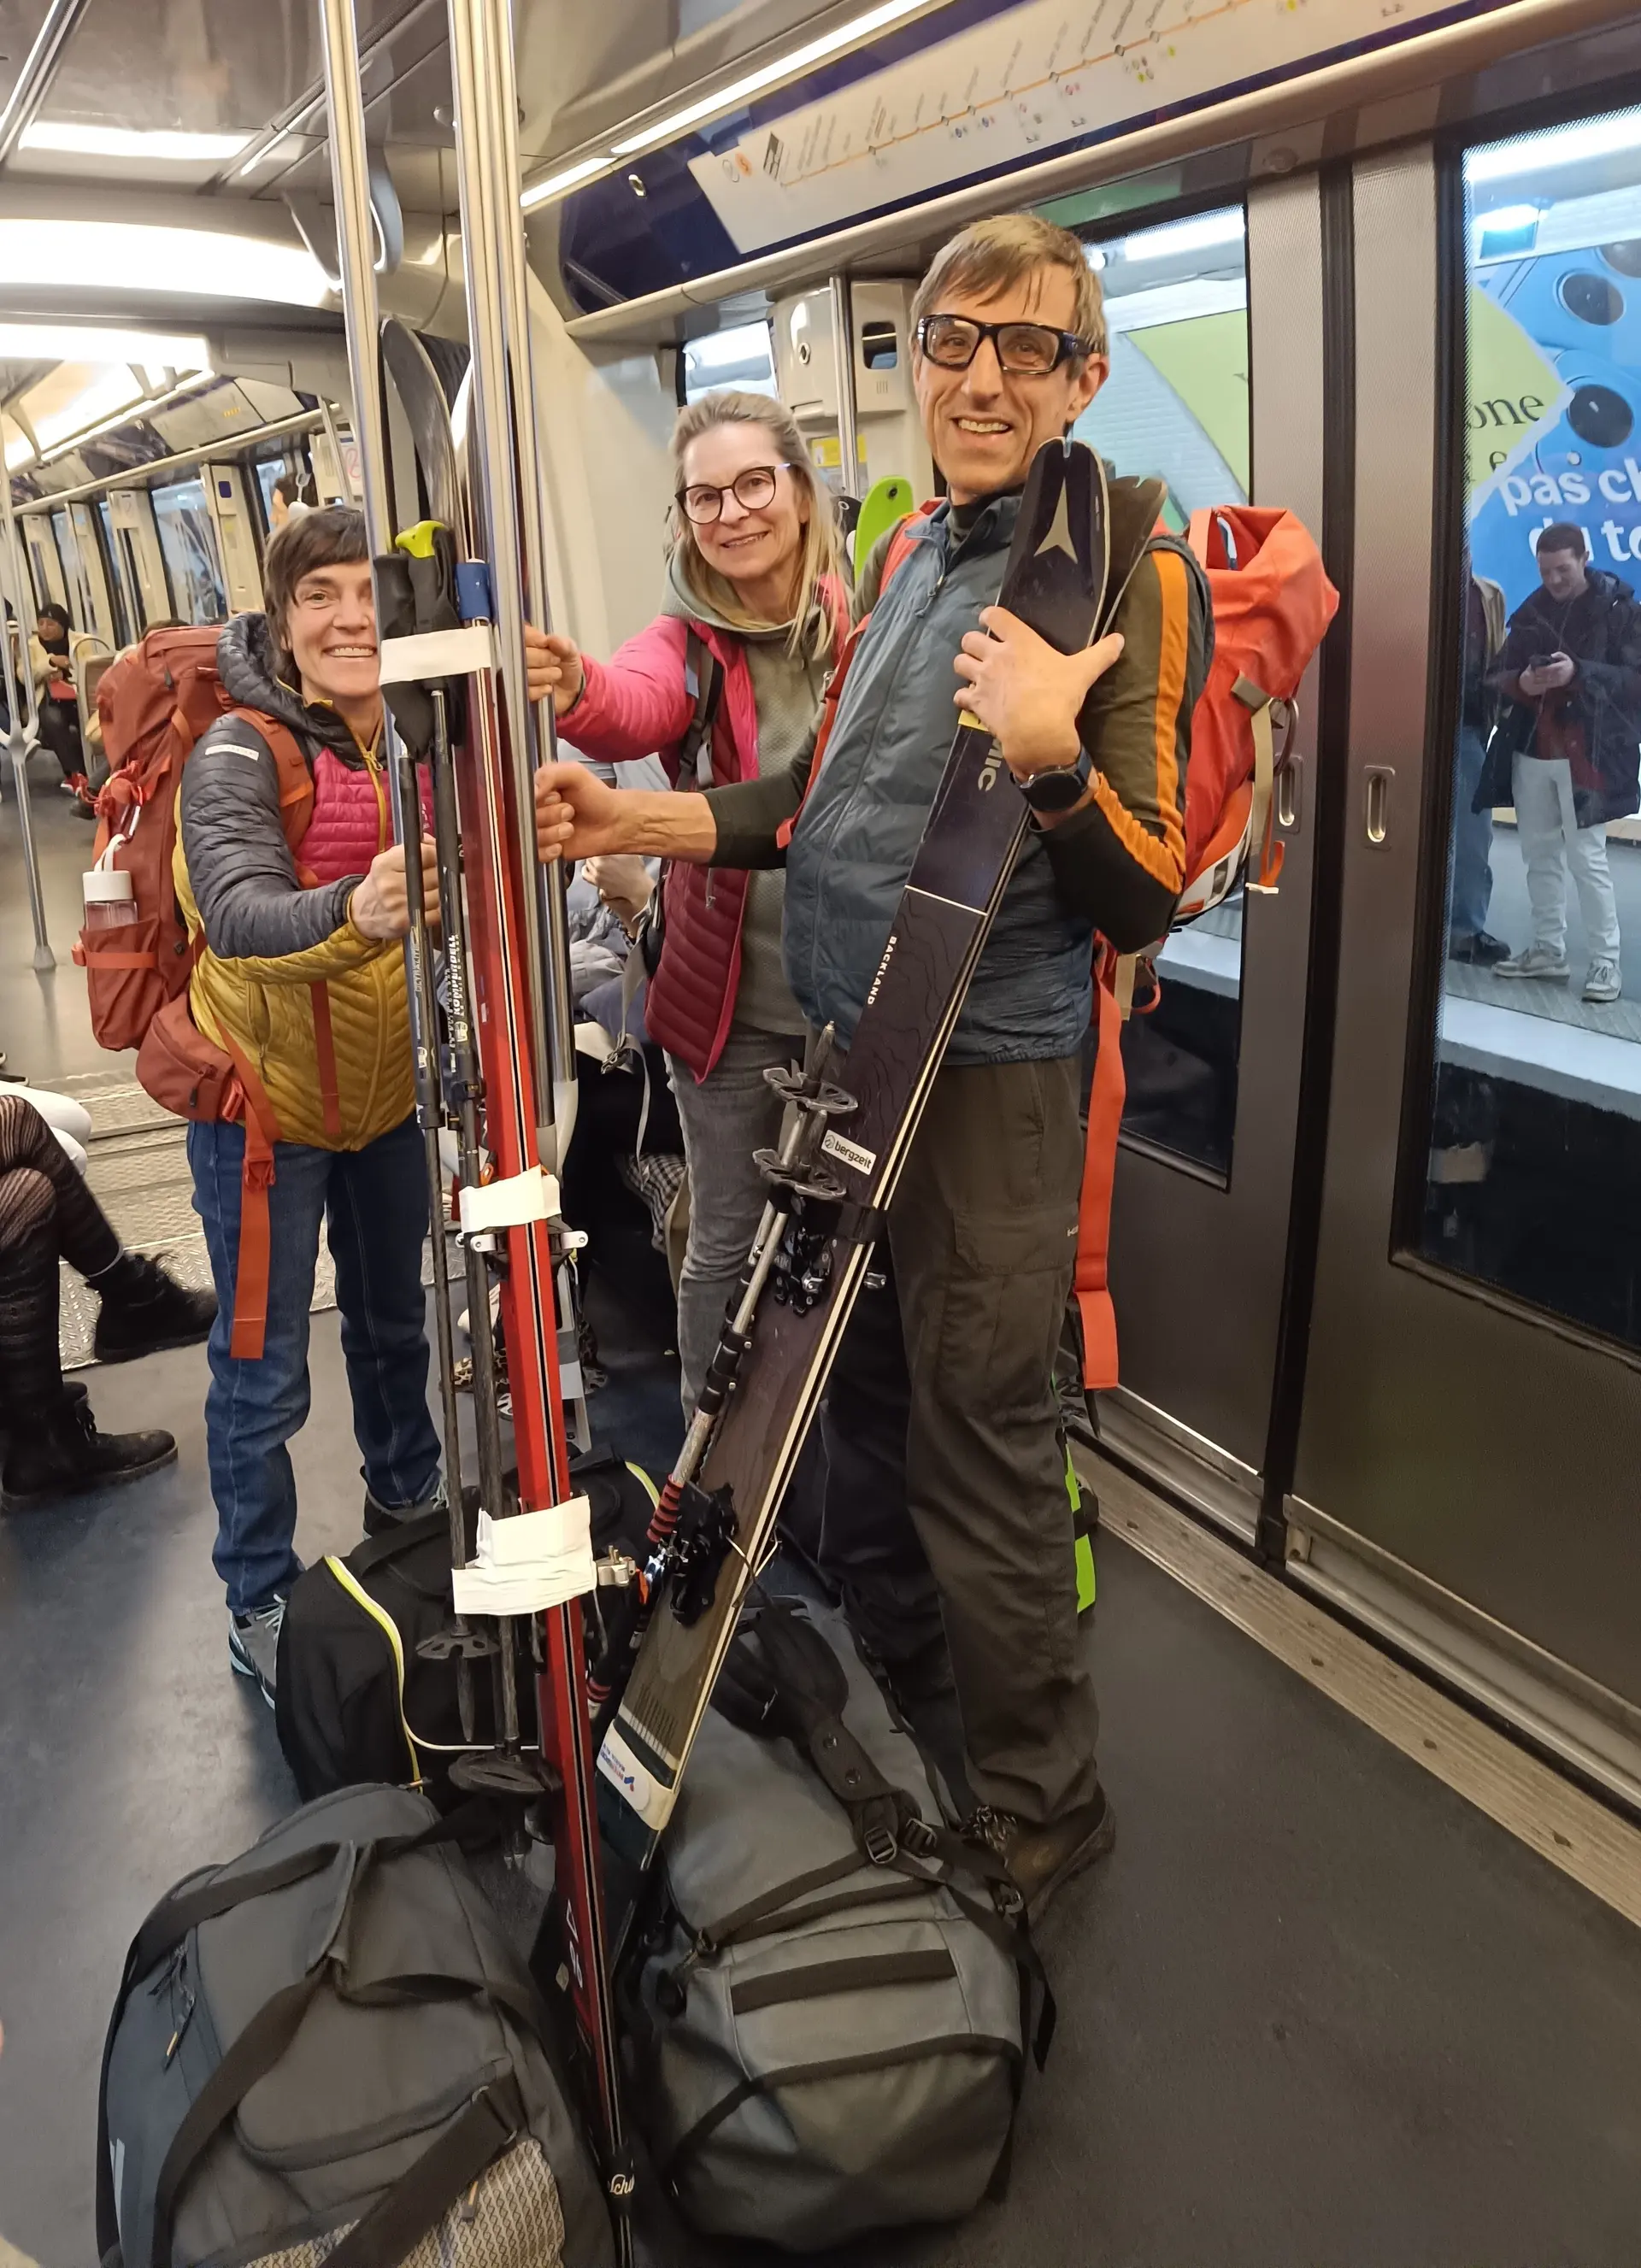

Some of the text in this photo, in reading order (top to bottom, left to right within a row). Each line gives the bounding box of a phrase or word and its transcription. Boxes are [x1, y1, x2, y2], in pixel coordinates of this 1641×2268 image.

[1499, 473, 1591, 516] pas
[868, 936, 897, 1005] BACKLAND
[834, 1140, 872, 1169] bergzeit
